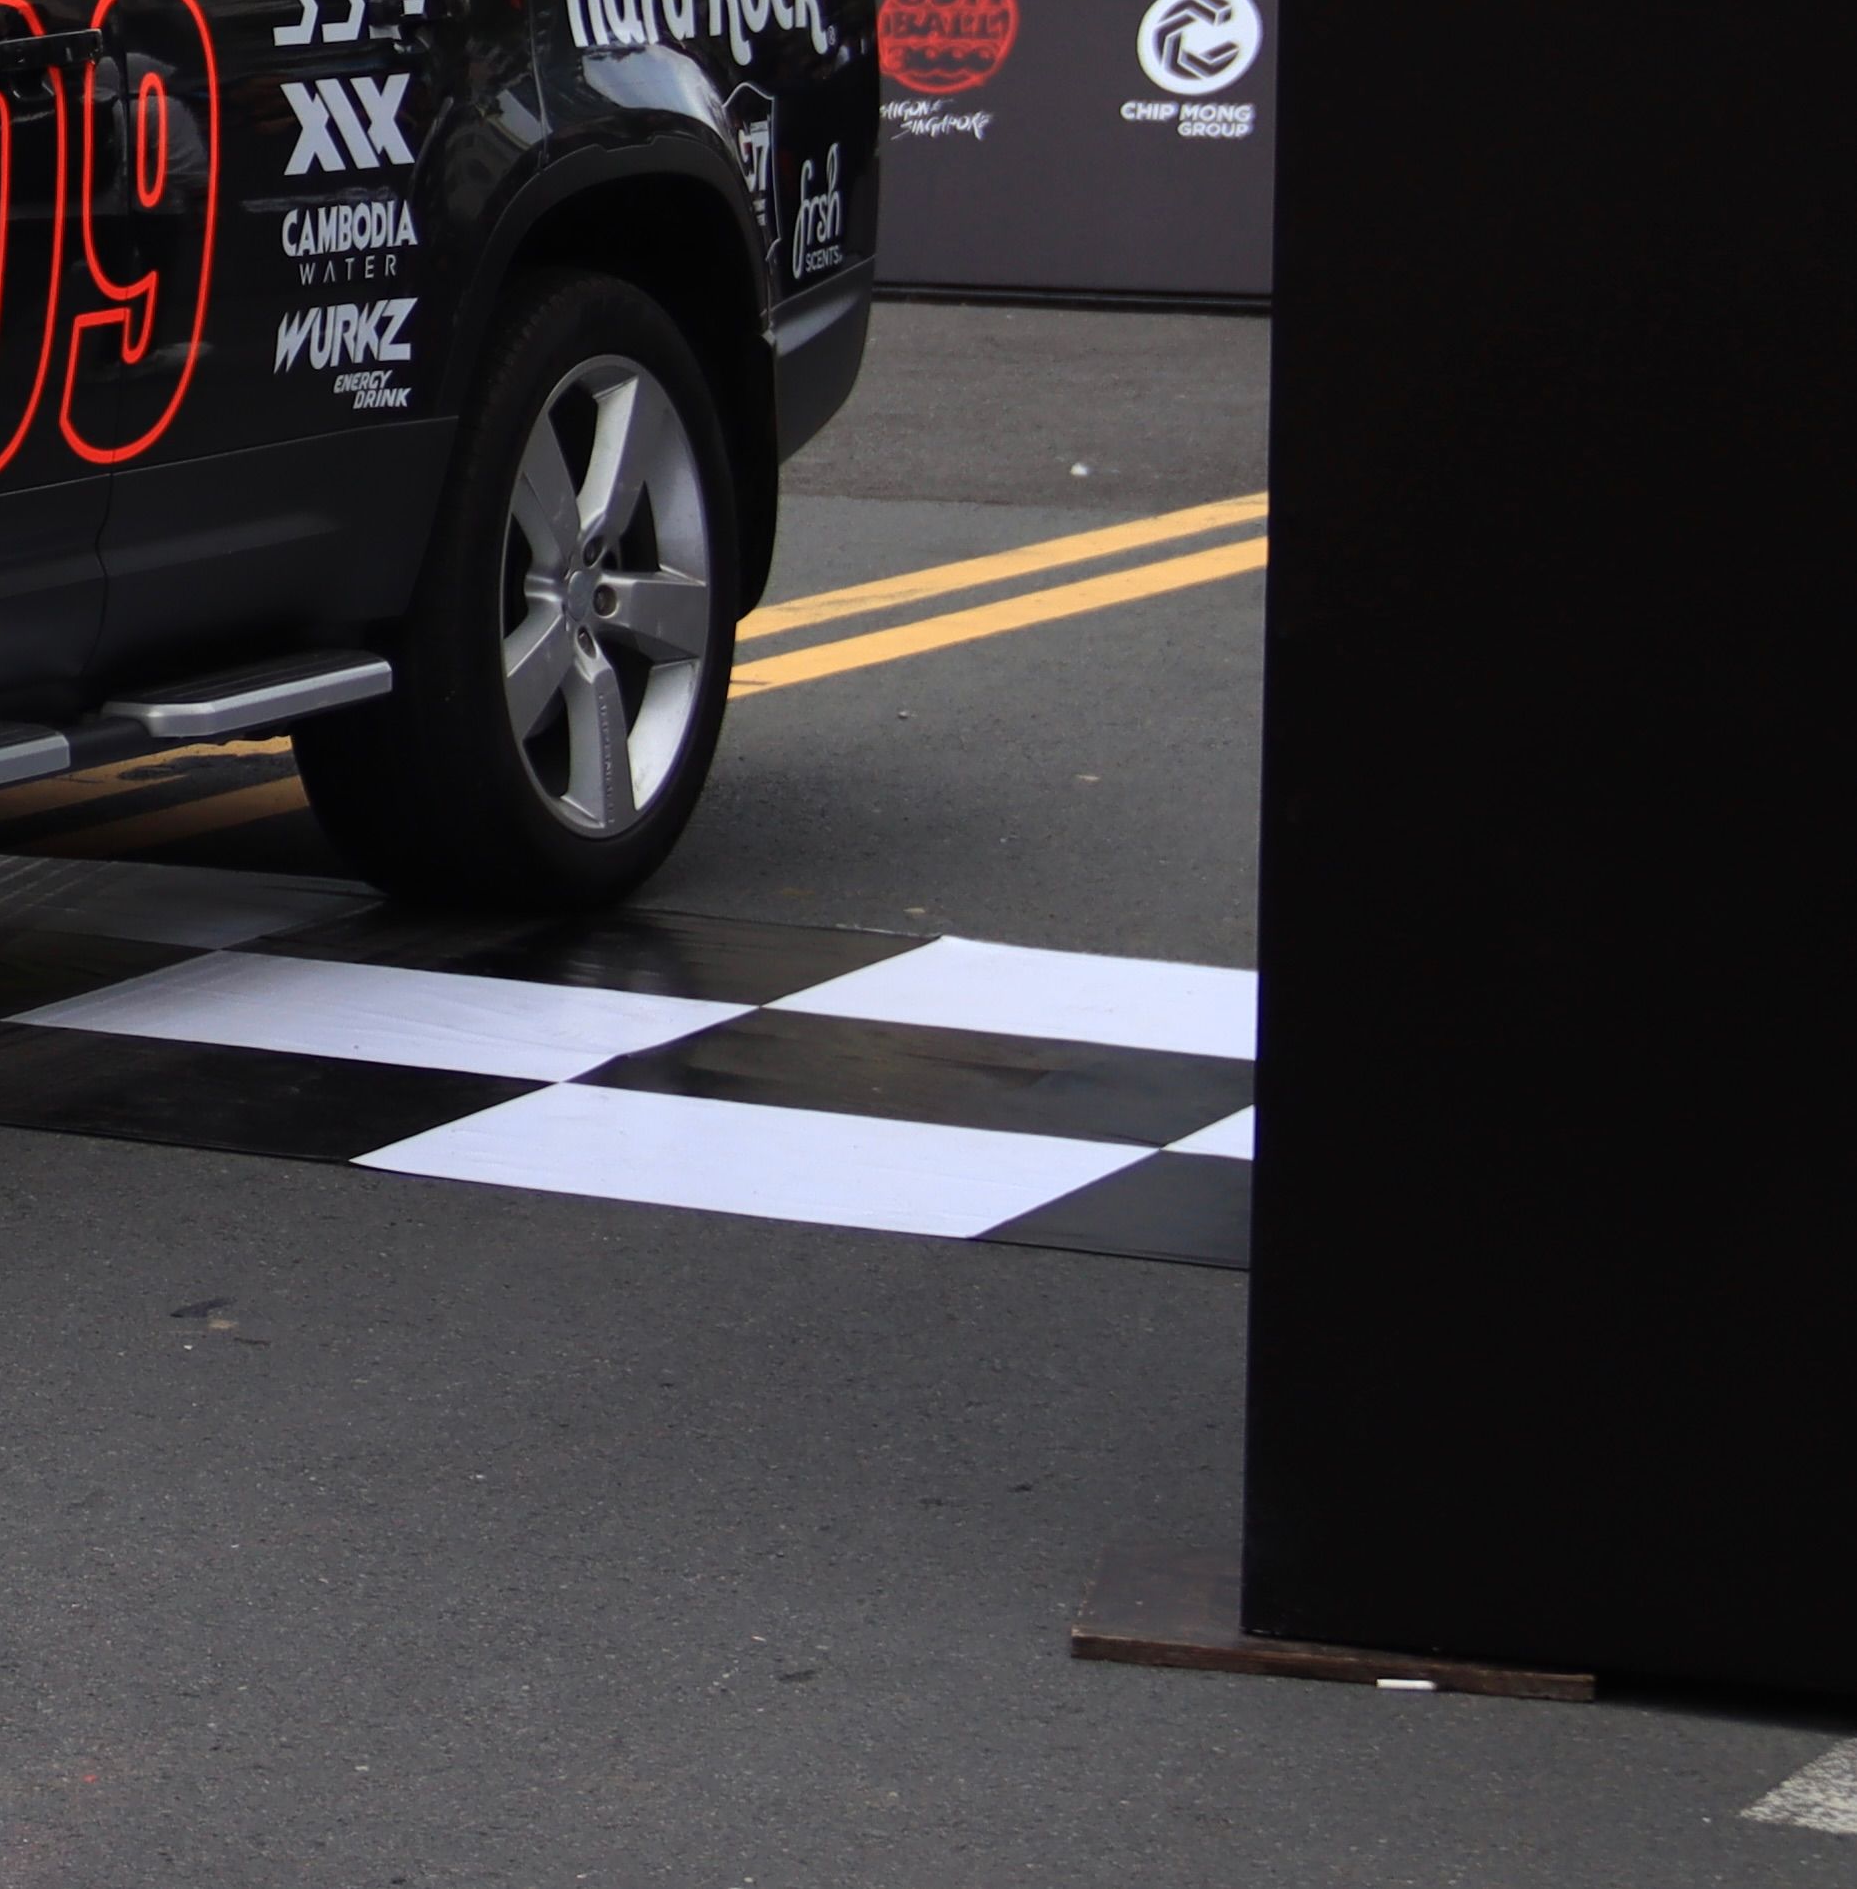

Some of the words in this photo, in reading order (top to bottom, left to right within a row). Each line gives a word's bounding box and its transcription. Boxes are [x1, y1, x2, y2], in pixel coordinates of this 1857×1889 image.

[1121, 100, 1177, 121] CHIP
[1180, 101, 1253, 122] MONG
[1178, 121, 1251, 138] GROUP
[281, 198, 419, 258] CAMBODIA
[299, 254, 398, 286] WATER
[273, 297, 419, 375] WURKZ
[332, 369, 393, 394] ENERGY
[352, 387, 412, 410] DRINK
